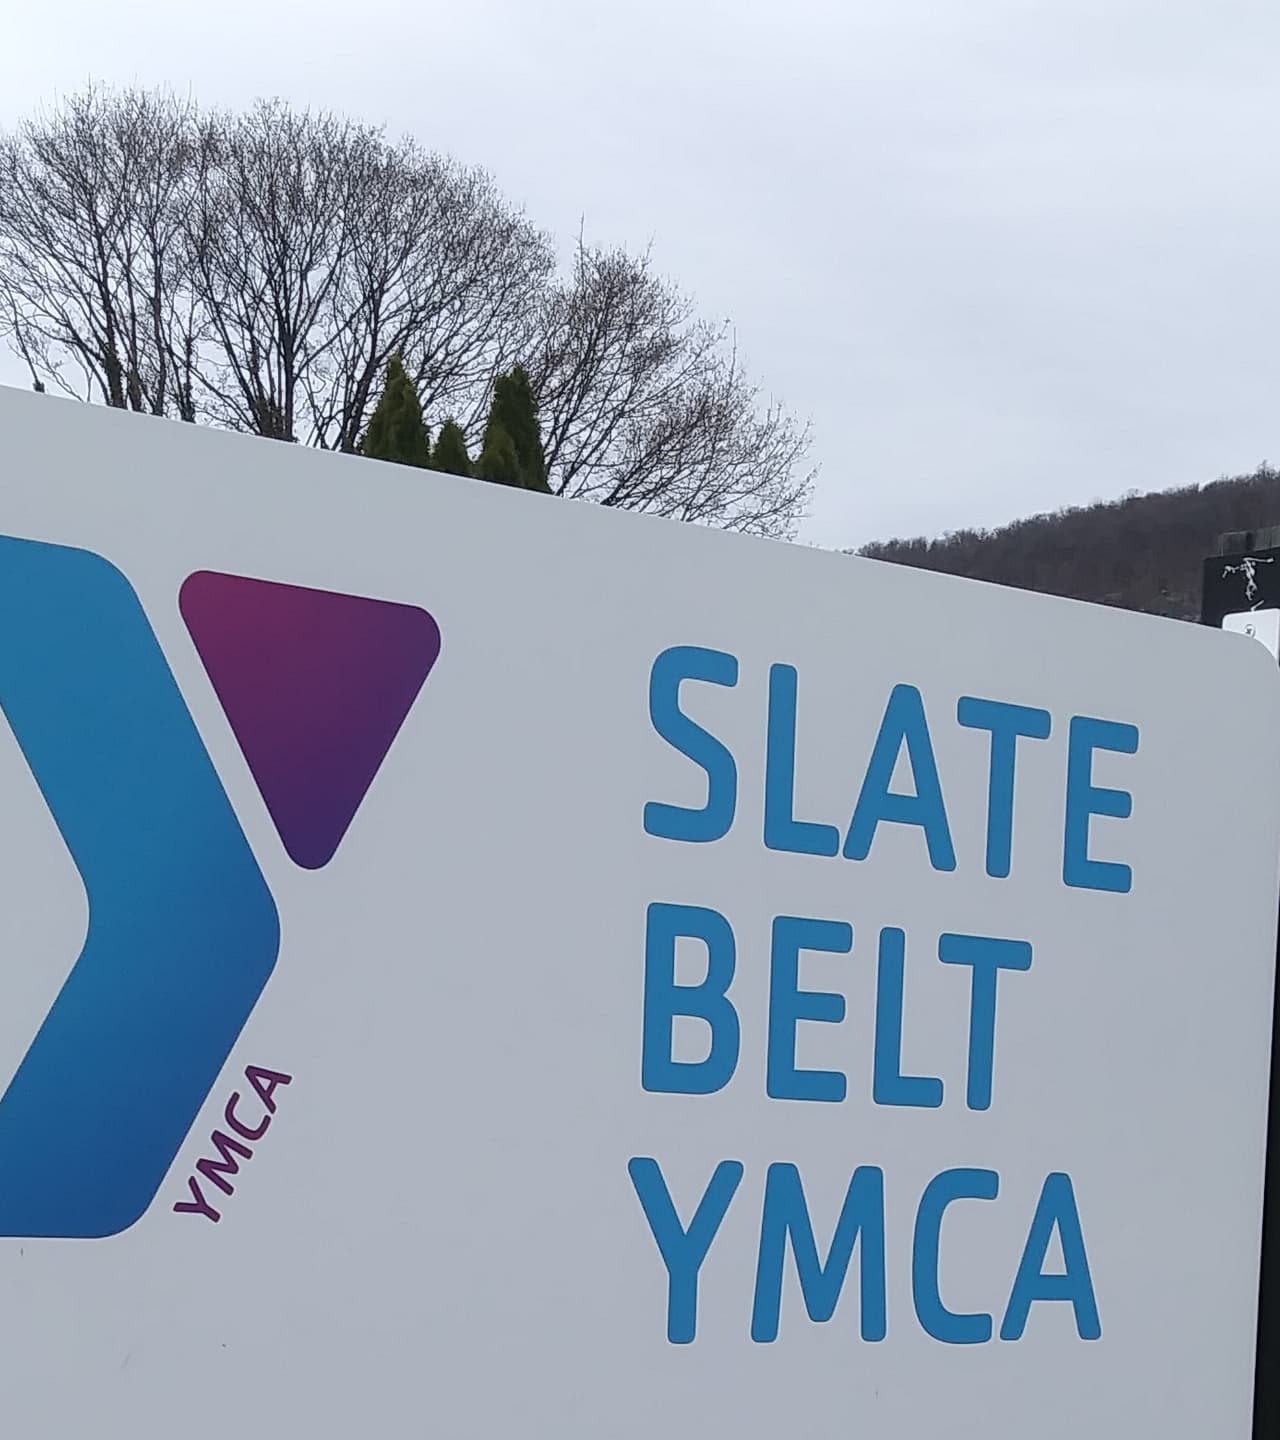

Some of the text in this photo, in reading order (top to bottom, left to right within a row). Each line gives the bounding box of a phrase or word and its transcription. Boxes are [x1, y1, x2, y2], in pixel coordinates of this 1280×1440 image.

[641, 644, 1140, 895] SLATE
[640, 900, 1034, 1113] BELT
[170, 1063, 294, 1224] YMCA
[626, 1155, 1103, 1346] YMCA
